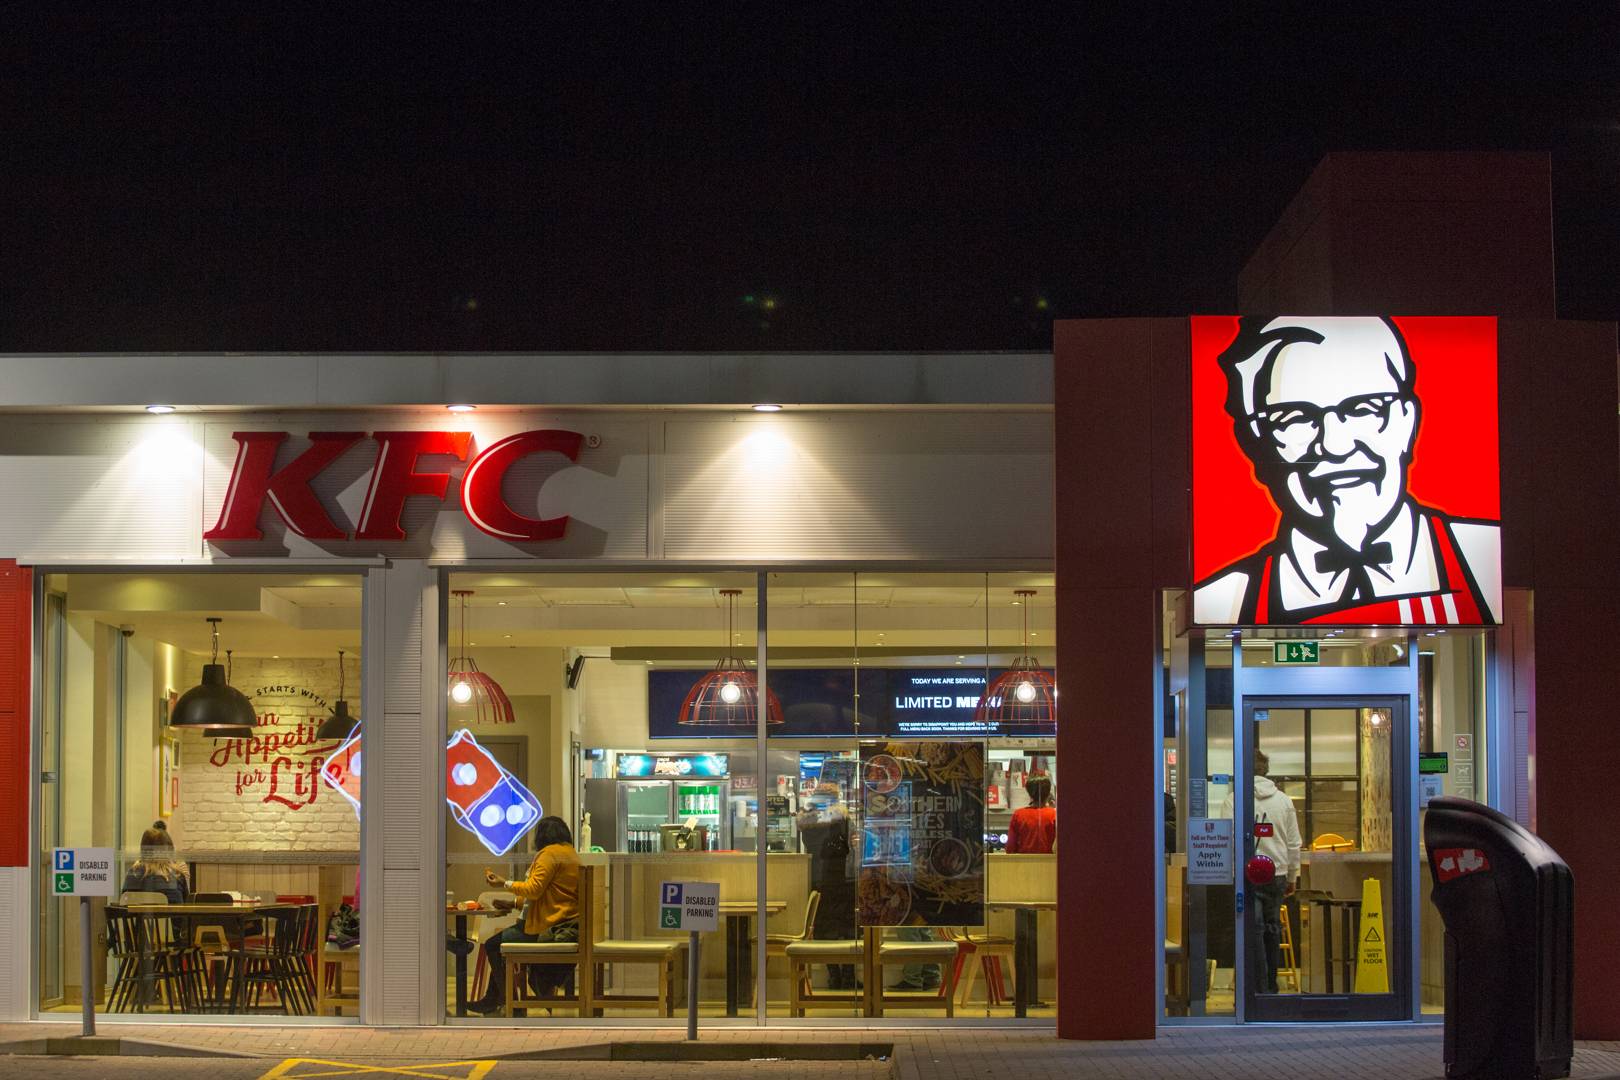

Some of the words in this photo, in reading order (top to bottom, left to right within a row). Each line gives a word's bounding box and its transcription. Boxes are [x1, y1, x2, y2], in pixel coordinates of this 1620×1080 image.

[203, 428, 585, 543] KFC
[911, 677, 931, 685] TODAY
[932, 677, 942, 685] WE
[942, 677, 955, 685] ARE
[955, 677, 981, 685] SERVING
[981, 677, 987, 685] A
[256, 685, 296, 697] STARTS
[300, 689, 327, 709] WITH
[895, 696, 953, 709] LIMITED
[210, 717, 341, 767] Appeti
[235, 769, 267, 796] for
[263, 756, 345, 811] Life
[58, 851, 71, 869] P
[1198, 851, 1222, 860] Apply
[80, 861, 109, 870] DISABLED
[1196, 860, 1224, 868] Within
[80, 873, 107, 881] PARKING
[666, 884, 679, 904] P
[685, 896, 716, 906] DISABLED
[686, 908, 714, 918] PARKING
